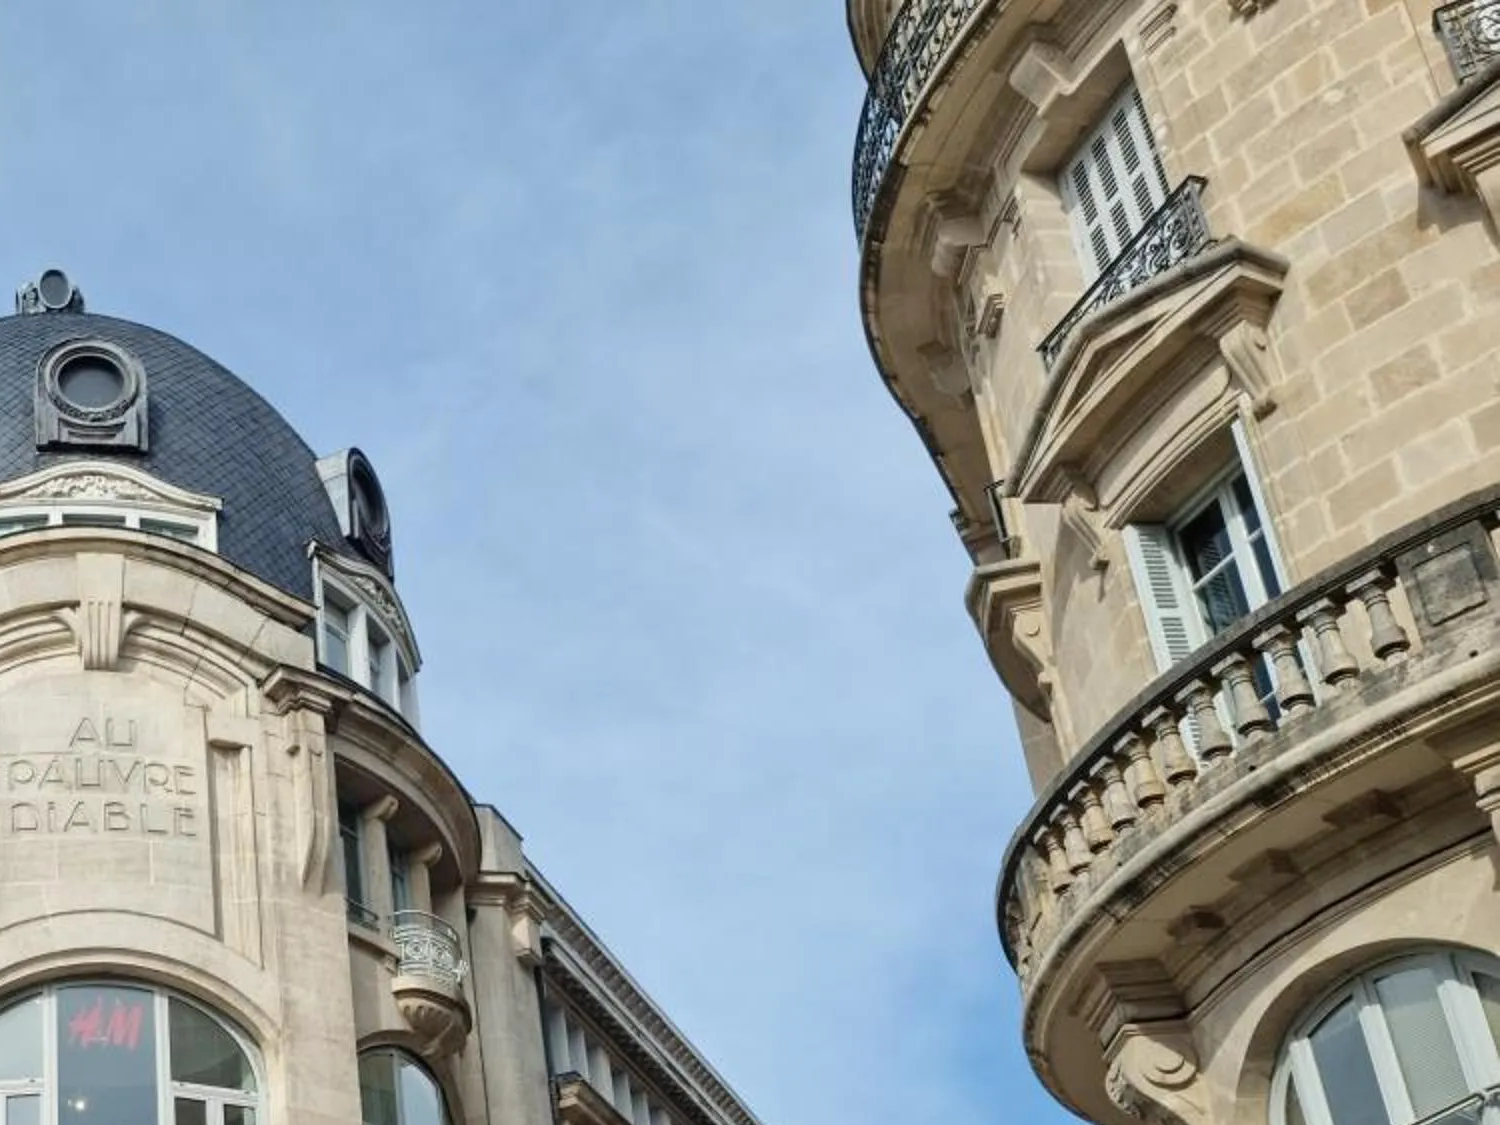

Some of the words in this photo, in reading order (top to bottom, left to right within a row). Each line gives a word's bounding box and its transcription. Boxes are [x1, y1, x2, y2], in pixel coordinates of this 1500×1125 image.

[68, 716, 138, 749] AU
[8, 757, 197, 796] PAUVRE
[11, 800, 197, 837] DIABLE
